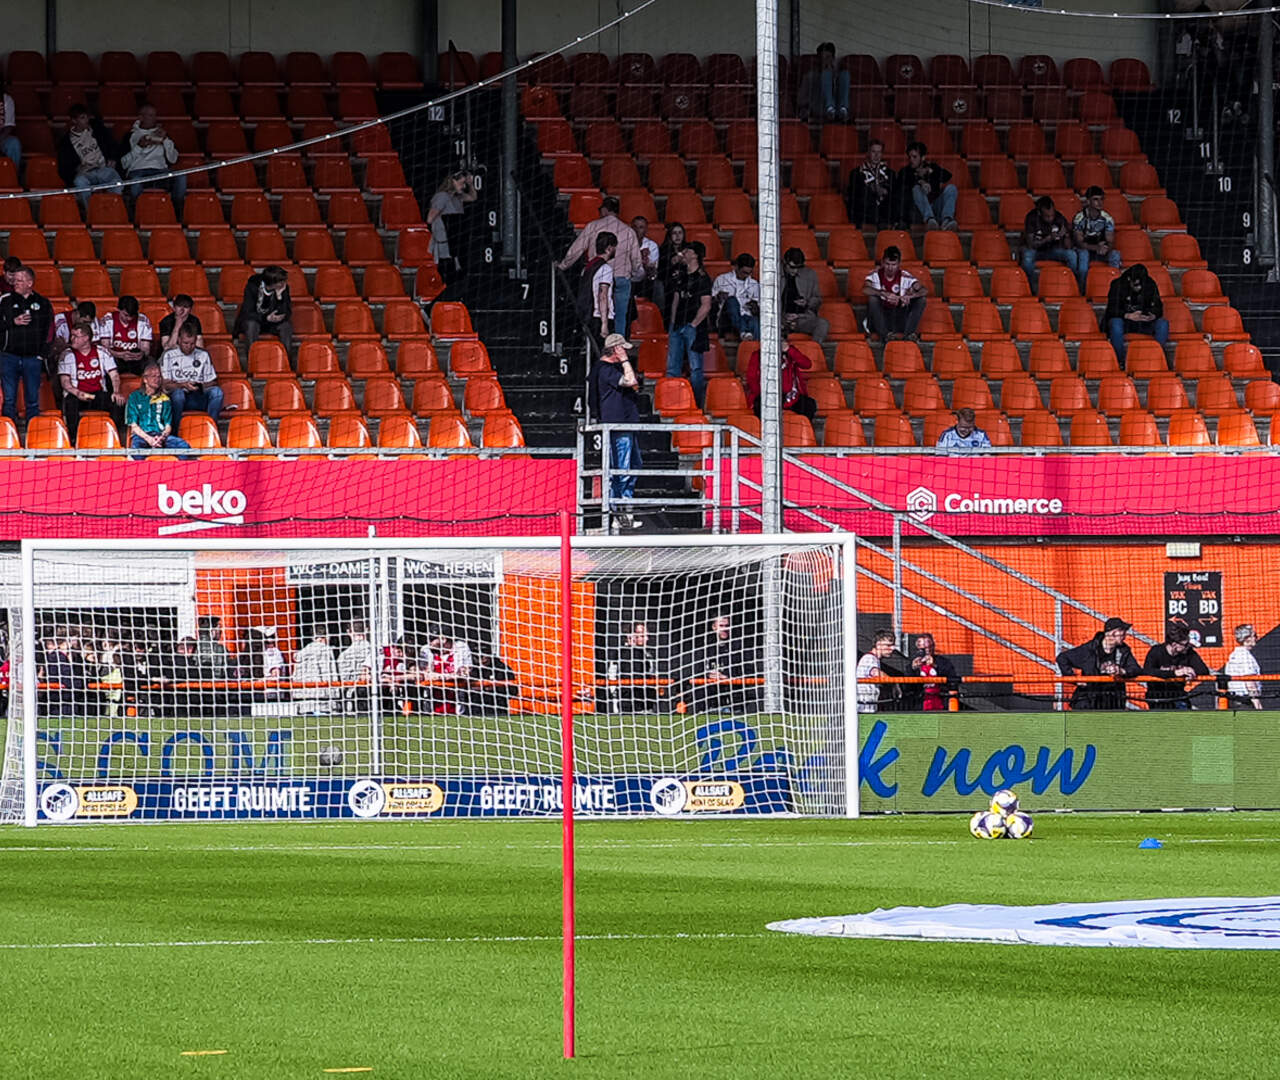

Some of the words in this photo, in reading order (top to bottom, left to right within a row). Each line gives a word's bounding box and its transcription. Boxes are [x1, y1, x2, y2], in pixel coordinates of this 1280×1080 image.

[1168, 109, 1181, 124] 12
[455, 141, 466, 156] 11
[1200, 142, 1211, 158] 11
[1218, 177, 1232, 192] 10
[489, 211, 496, 226] 9
[1242, 212, 1251, 227] 9
[485, 248, 493, 263] 8
[1242, 248, 1251, 264] 8
[521, 284, 530, 300] 7
[539, 320, 548, 336] 6
[559, 358, 568, 375] 5
[573, 397, 583, 413] 4
[593, 434, 602, 450] 3
[158, 483, 247, 515] beko
[944, 493, 1062, 513] Coinmerce
[329, 562, 379, 575] DAME
[1169, 600, 1187, 614] BC
[1199, 600, 1218, 614] BD
[922, 743, 1097, 797] now
[173, 787, 233, 811] GEEFT
[238, 787, 311, 811] RUIMTE
[480, 785, 538, 810] GEEFT
[543, 785, 616, 810] RUMTE
